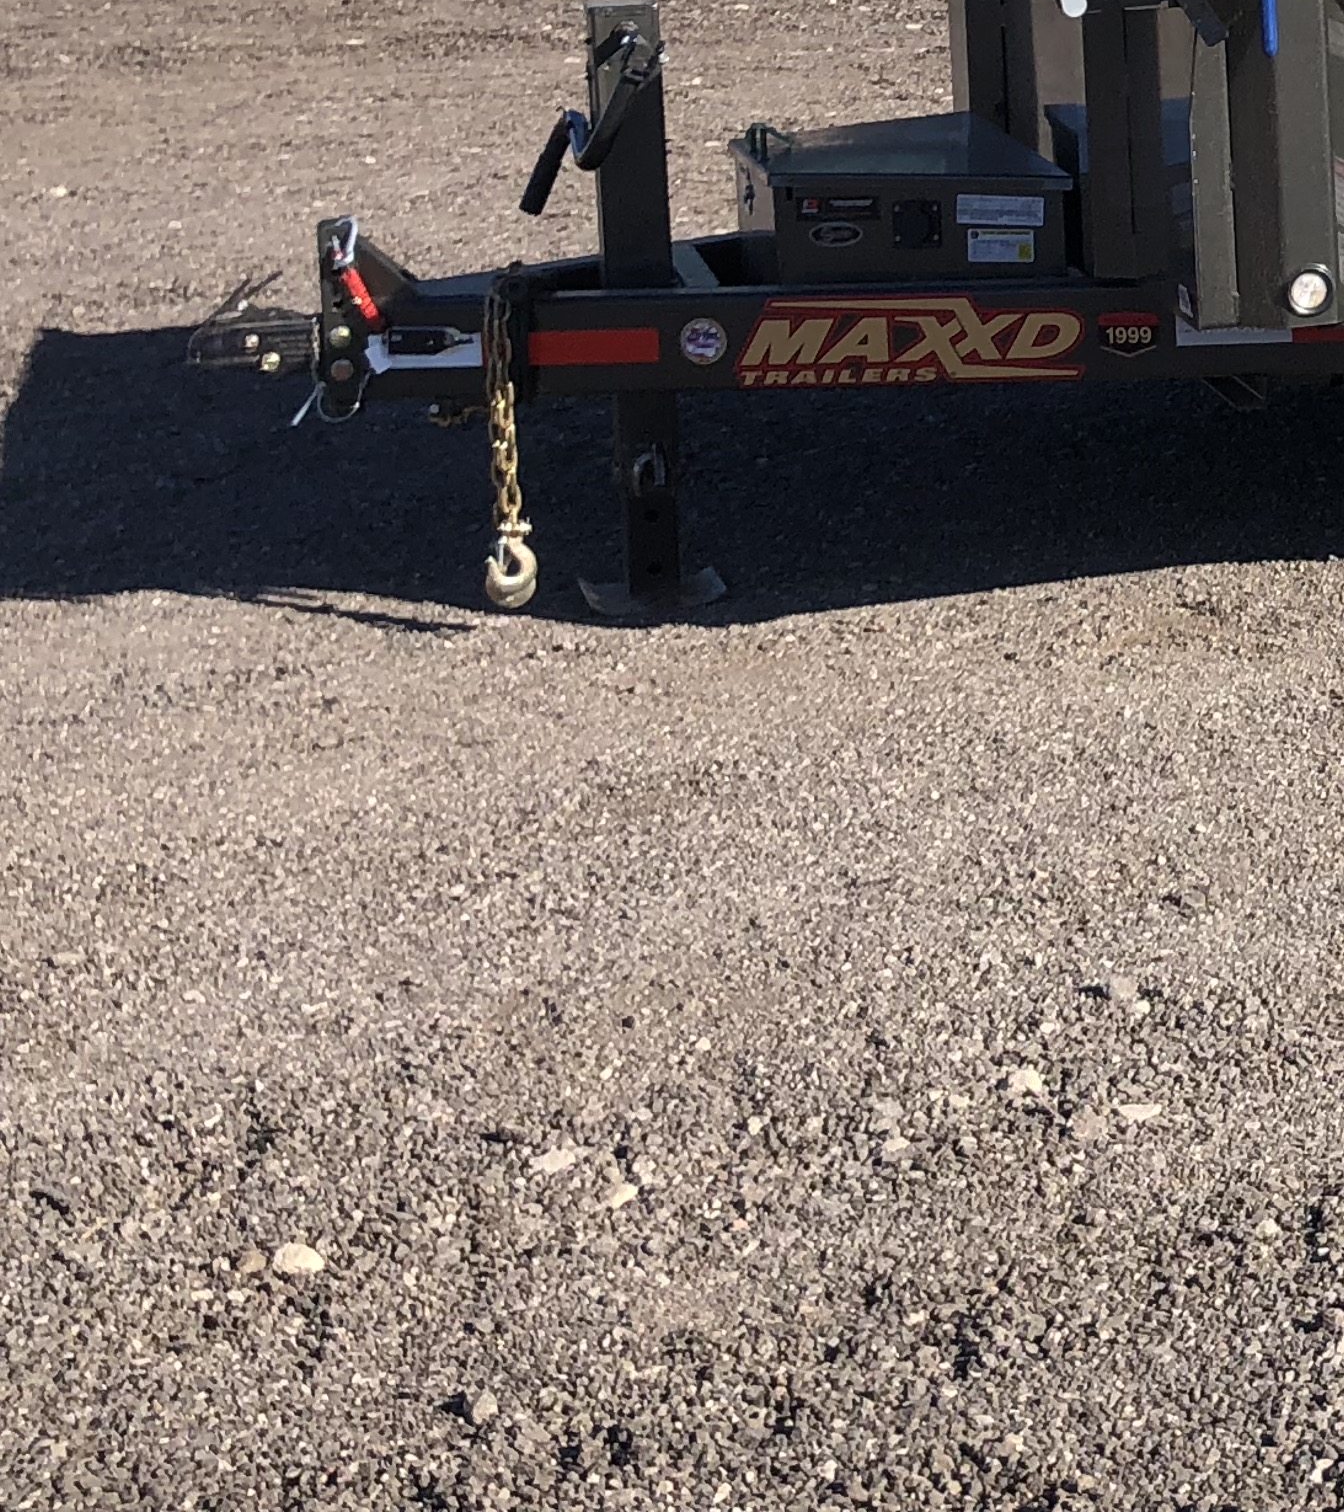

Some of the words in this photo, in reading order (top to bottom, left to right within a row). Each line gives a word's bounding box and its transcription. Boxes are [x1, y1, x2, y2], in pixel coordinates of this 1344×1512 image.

[741, 311, 1083, 366] MAXXD
[1104, 326, 1153, 345] 1999
[741, 367, 940, 386] TRAILERS
